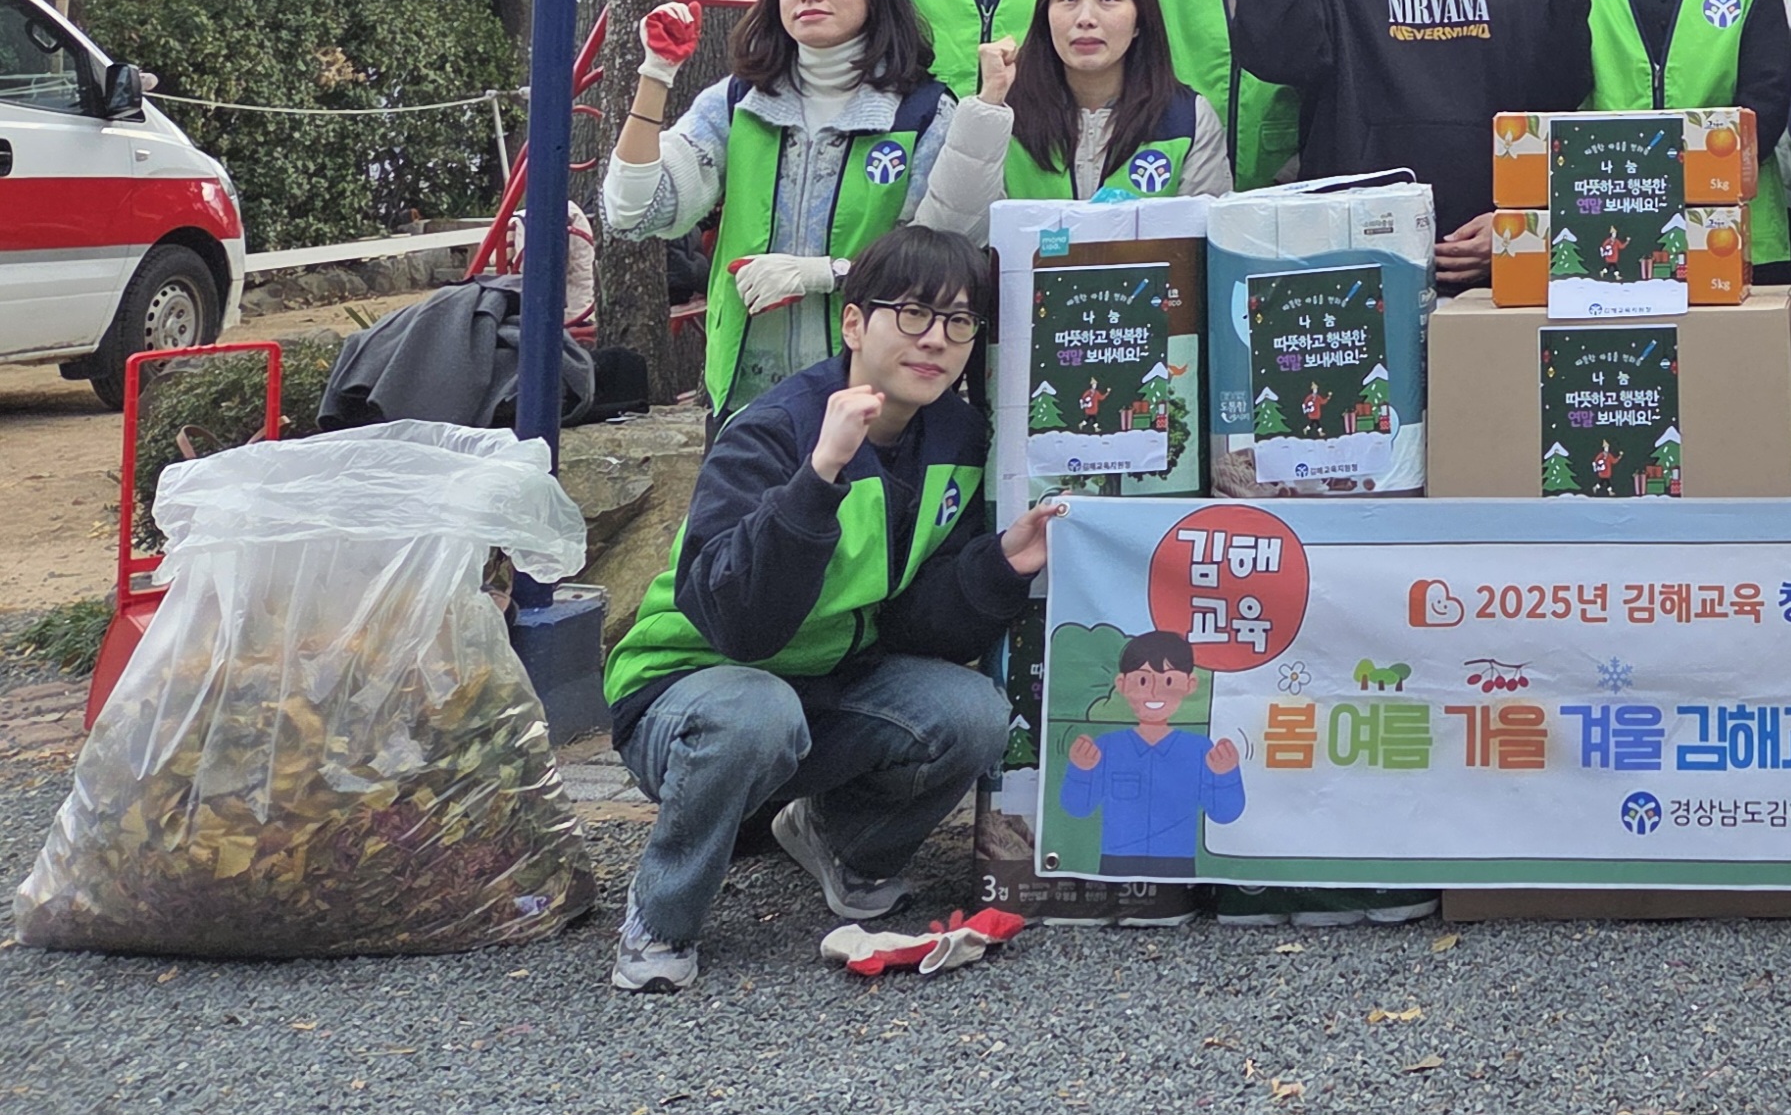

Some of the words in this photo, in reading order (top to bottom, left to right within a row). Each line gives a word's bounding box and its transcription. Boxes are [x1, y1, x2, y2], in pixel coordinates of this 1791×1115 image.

[1389, 23, 1491, 40] NEVERMIND
[1574, 179, 1626, 195] 따뜻하고
[1627, 178, 1666, 195] 행복한
[1710, 178, 1730, 191] 5kg
[1577, 198, 1602, 214] 연말
[1711, 278, 1731, 291] 5kg
[1055, 330, 1108, 346] 따뜻하고
[1109, 328, 1149, 345] 행복한
[1273, 334, 1325, 352] 따뜻하고
[1326, 329, 1367, 348] 행복한
[1057, 349, 1083, 366] 연말
[1276, 354, 1302, 371] 연말
[1566, 391, 1618, 408] 따뜻하고
[1620, 390, 1659, 407] 행복한
[1568, 410, 1594, 427] 연말
[1177, 529, 1283, 588] 김해
[1475, 583, 1609, 624] 2025년
[1622, 582, 1765, 624] 김해교육
[1187, 596, 1272, 653] 교육
[1263, 703, 1318, 769] 봄
[1328, 703, 1433, 770] 여름
[1444, 704, 1548, 769] 가을
[1559, 704, 1665, 771] 겨울
